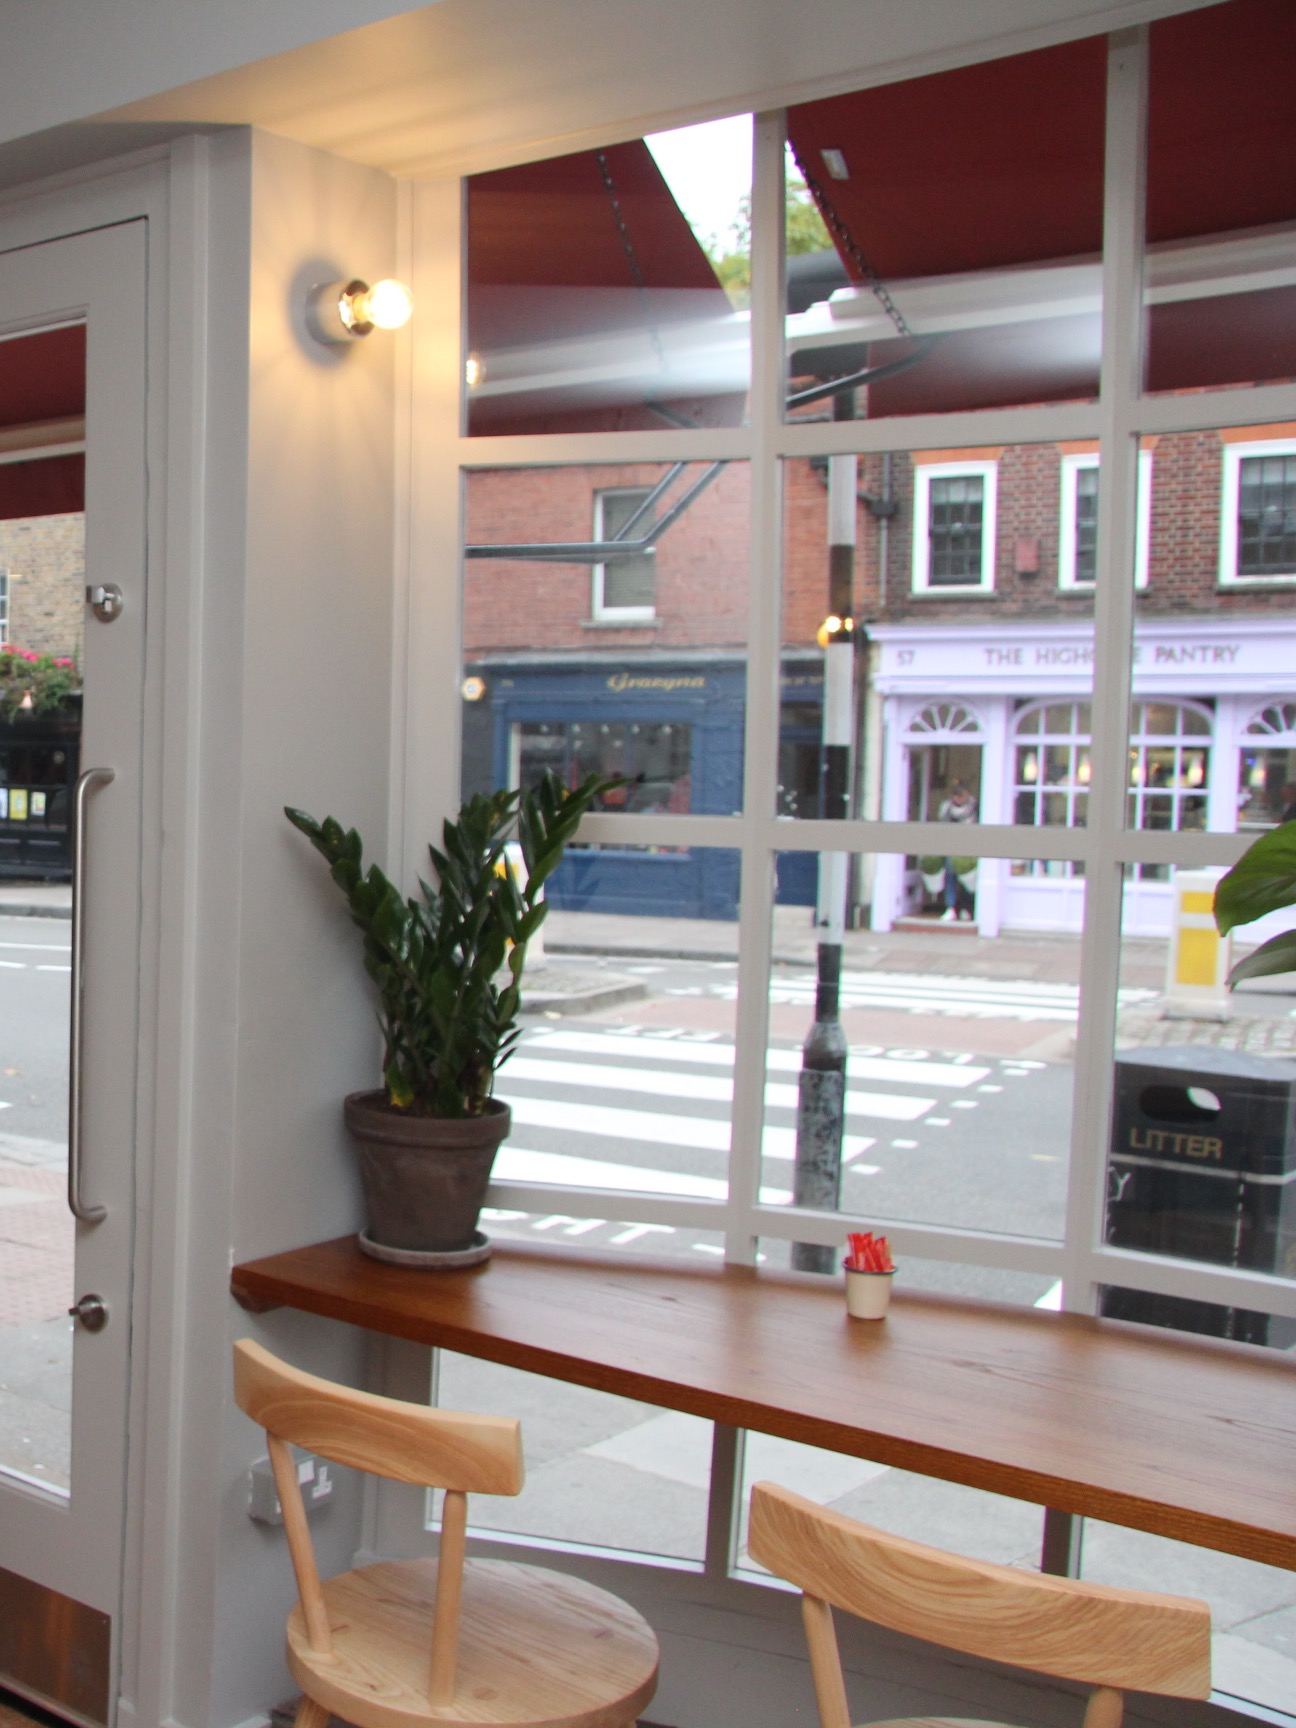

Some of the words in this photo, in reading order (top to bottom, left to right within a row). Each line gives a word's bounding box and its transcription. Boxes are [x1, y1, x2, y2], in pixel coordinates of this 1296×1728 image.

[984, 648, 1023, 665] THE
[1035, 646, 1141, 665] HIGHE
[1154, 644, 1241, 664] PANTRY
[1129, 1127, 1224, 1160] LITTER
